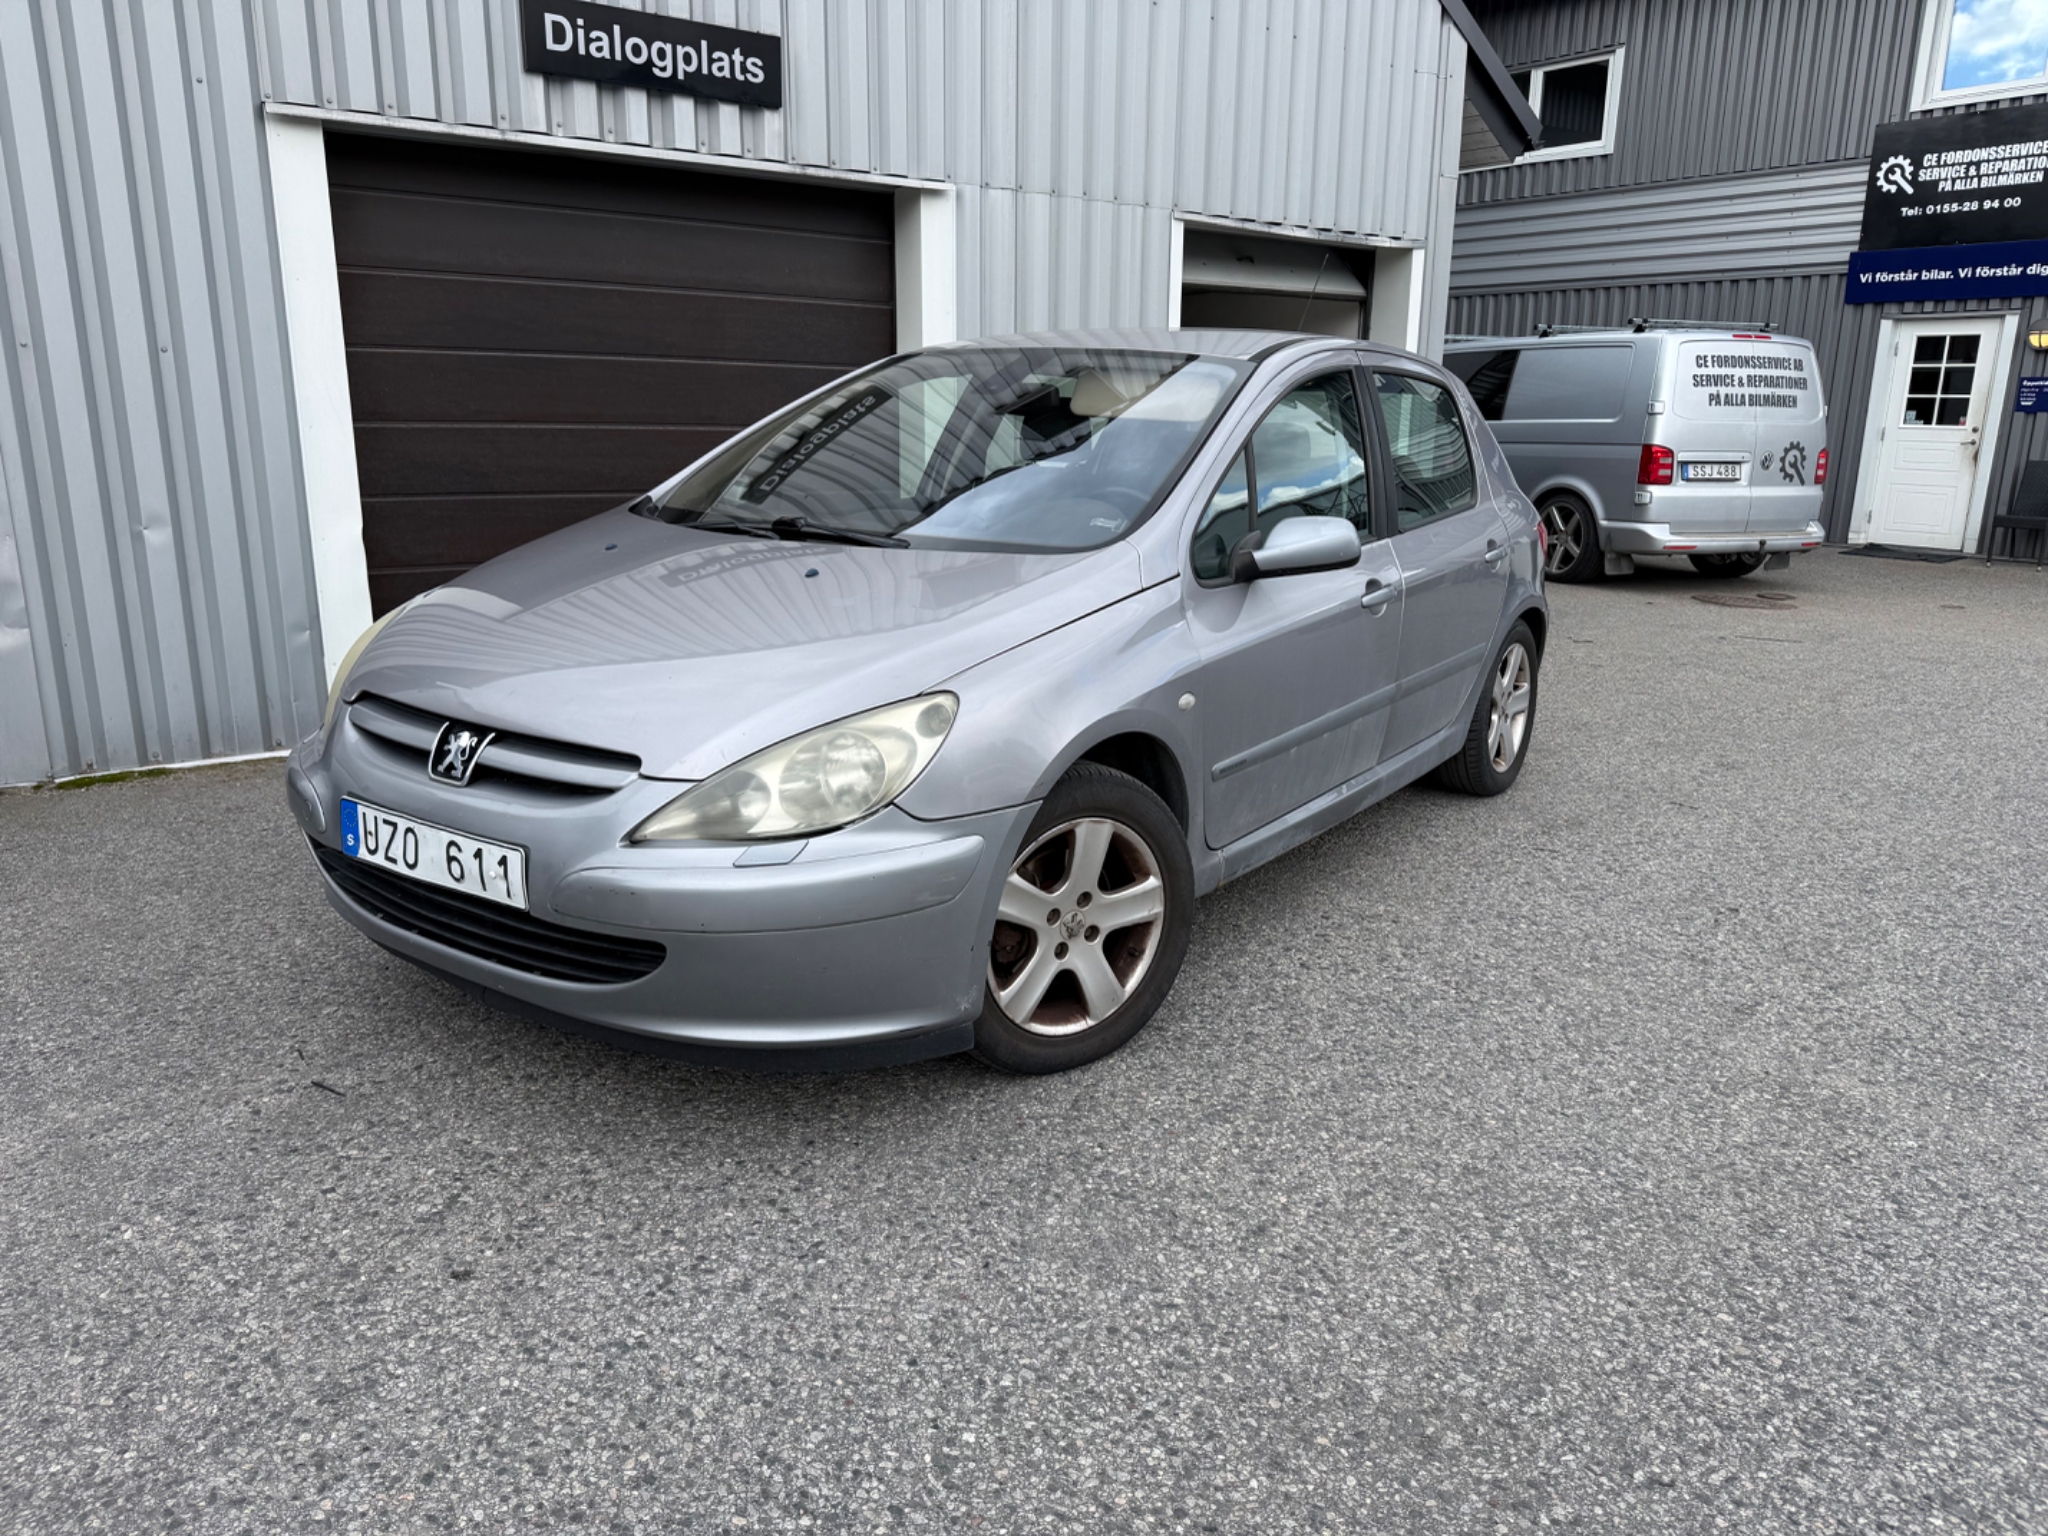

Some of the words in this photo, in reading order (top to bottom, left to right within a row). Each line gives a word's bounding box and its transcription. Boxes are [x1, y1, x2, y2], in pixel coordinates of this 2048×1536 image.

[544, 12, 765, 84] Dialogplats
[1923, 153, 1939, 167] CE
[1940, 140, 2048, 166] FORDONSSERVICE
[1918, 164, 1967, 181] SERVICE
[1968, 165, 1978, 177] &
[1979, 155, 2048, 175] REPARATIO
[1937, 176, 1952, 193] PÅ
[1953, 177, 1978, 191] ALLA
[1979, 170, 2044, 188] BILMÄRKEN
[1900, 207, 1923, 217] Tel:
[1925, 200, 1979, 215] 0155-28
[1983, 199, 2000, 210] 94
[2003, 196, 2022, 208] 00
[1860, 272, 1872, 284] Vi
[1875, 268, 1919, 283] förstår
[1921, 268, 1954, 281] bilar.
[1958, 267, 1972, 279] Vi
[1975, 263, 2024, 278] förstår
[1695, 354, 1709, 368] CE
[1711, 355, 1792, 371] FORDONSSERVICE
[1793, 358, 1804, 372] AB
[1692, 374, 1736, 388] SERVICE
[1737, 375, 1745, 387] &
[1746, 375, 1808, 390] REPARATIONER
[1708, 390, 1722, 407] PÅ
[1723, 393, 1746, 407] ALLA
[1748, 391, 1798, 408] BILMÄRKEN
[1693, 465, 1713, 477] SSJ
[1716, 464, 1737, 477] 488
[346, 833, 355, 847] S
[362, 811, 419, 871] UZO
[445, 839, 513, 900] 611
